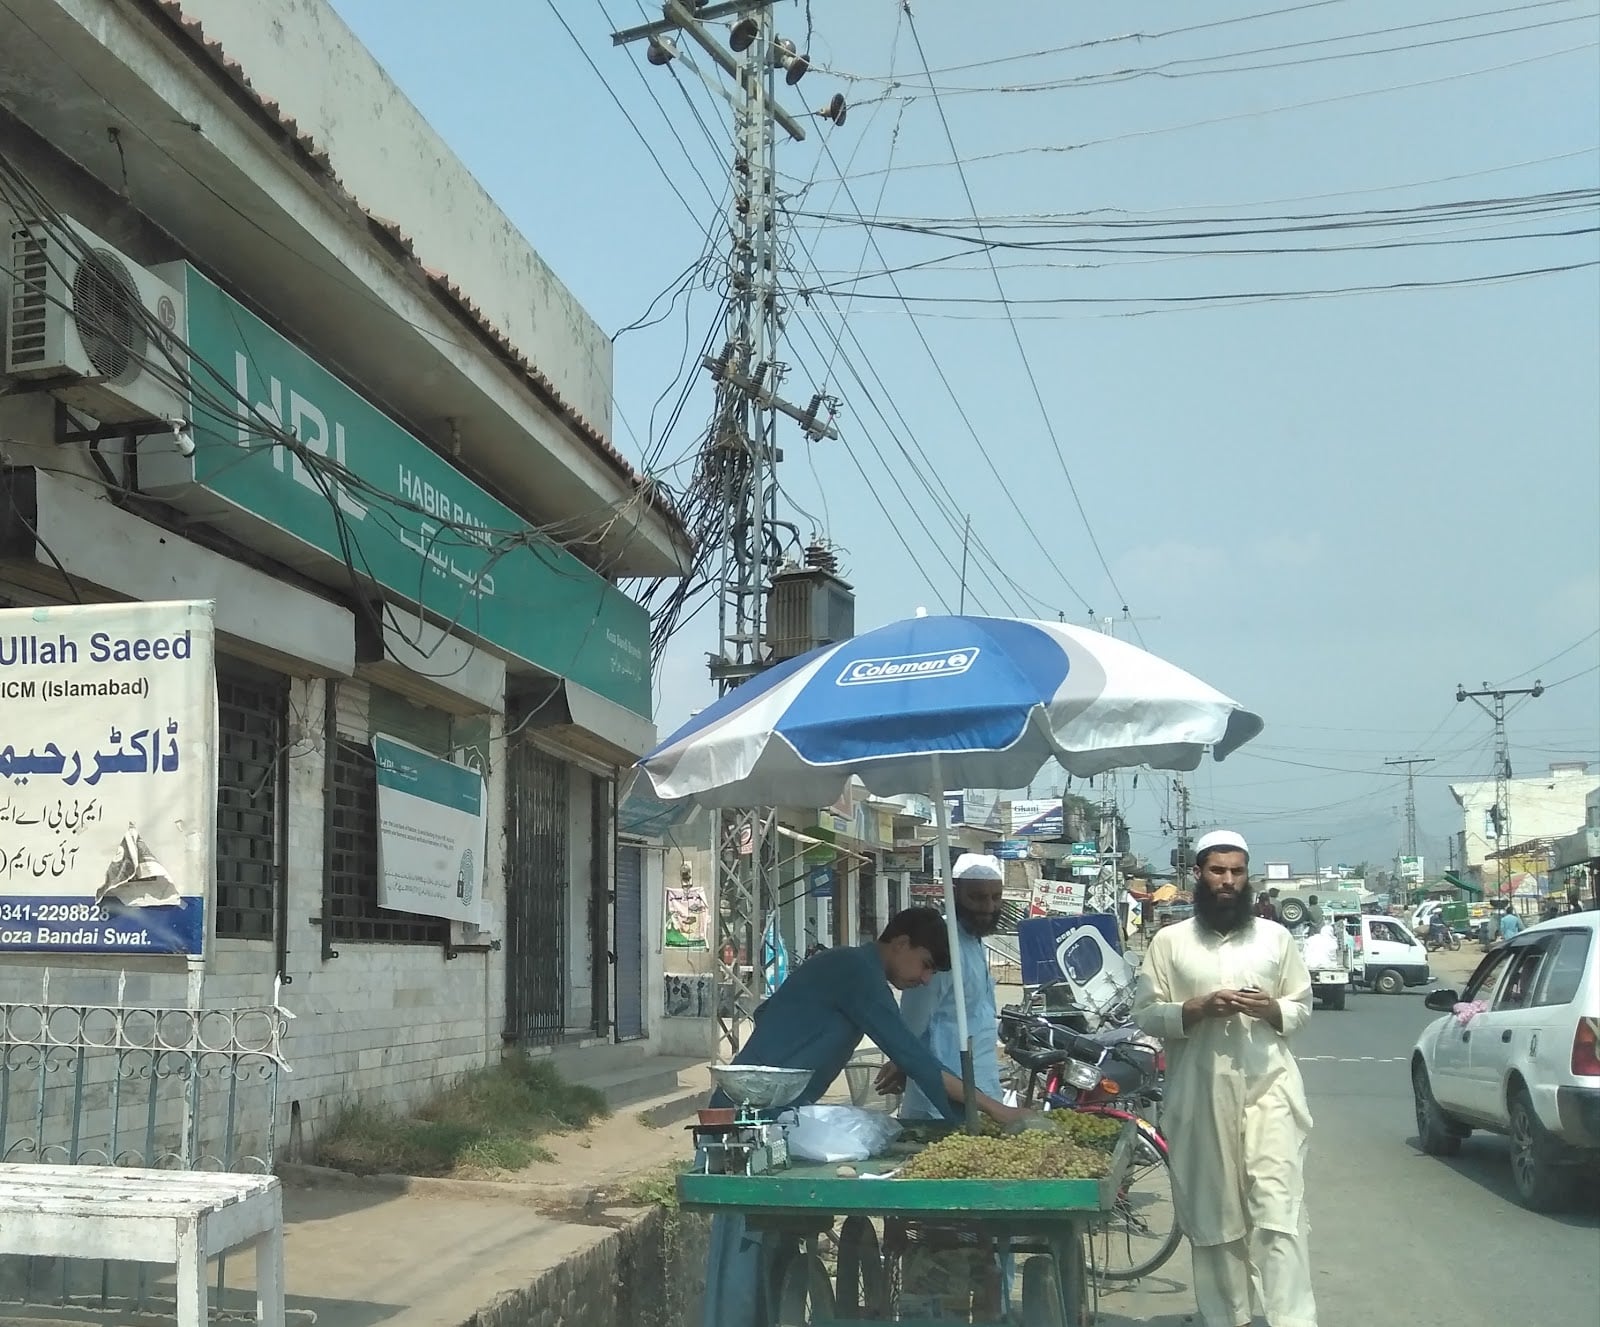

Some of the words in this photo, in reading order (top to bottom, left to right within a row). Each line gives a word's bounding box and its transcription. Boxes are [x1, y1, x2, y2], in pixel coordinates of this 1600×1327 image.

[235, 350, 369, 521] HBL
[399, 463, 451, 520] HABIB
[0, 634, 78, 666] Ullah
[90, 629, 191, 663] Saeed
[852, 660, 946, 678] Coleman
[42, 677, 149, 702] (Islamabad)
[83, 716, 180, 786] ڈاکٹر
[0, 904, 110, 922] 341-2298828
[37, 927, 99, 945] Bandai
[104, 928, 151, 945] Swat.
